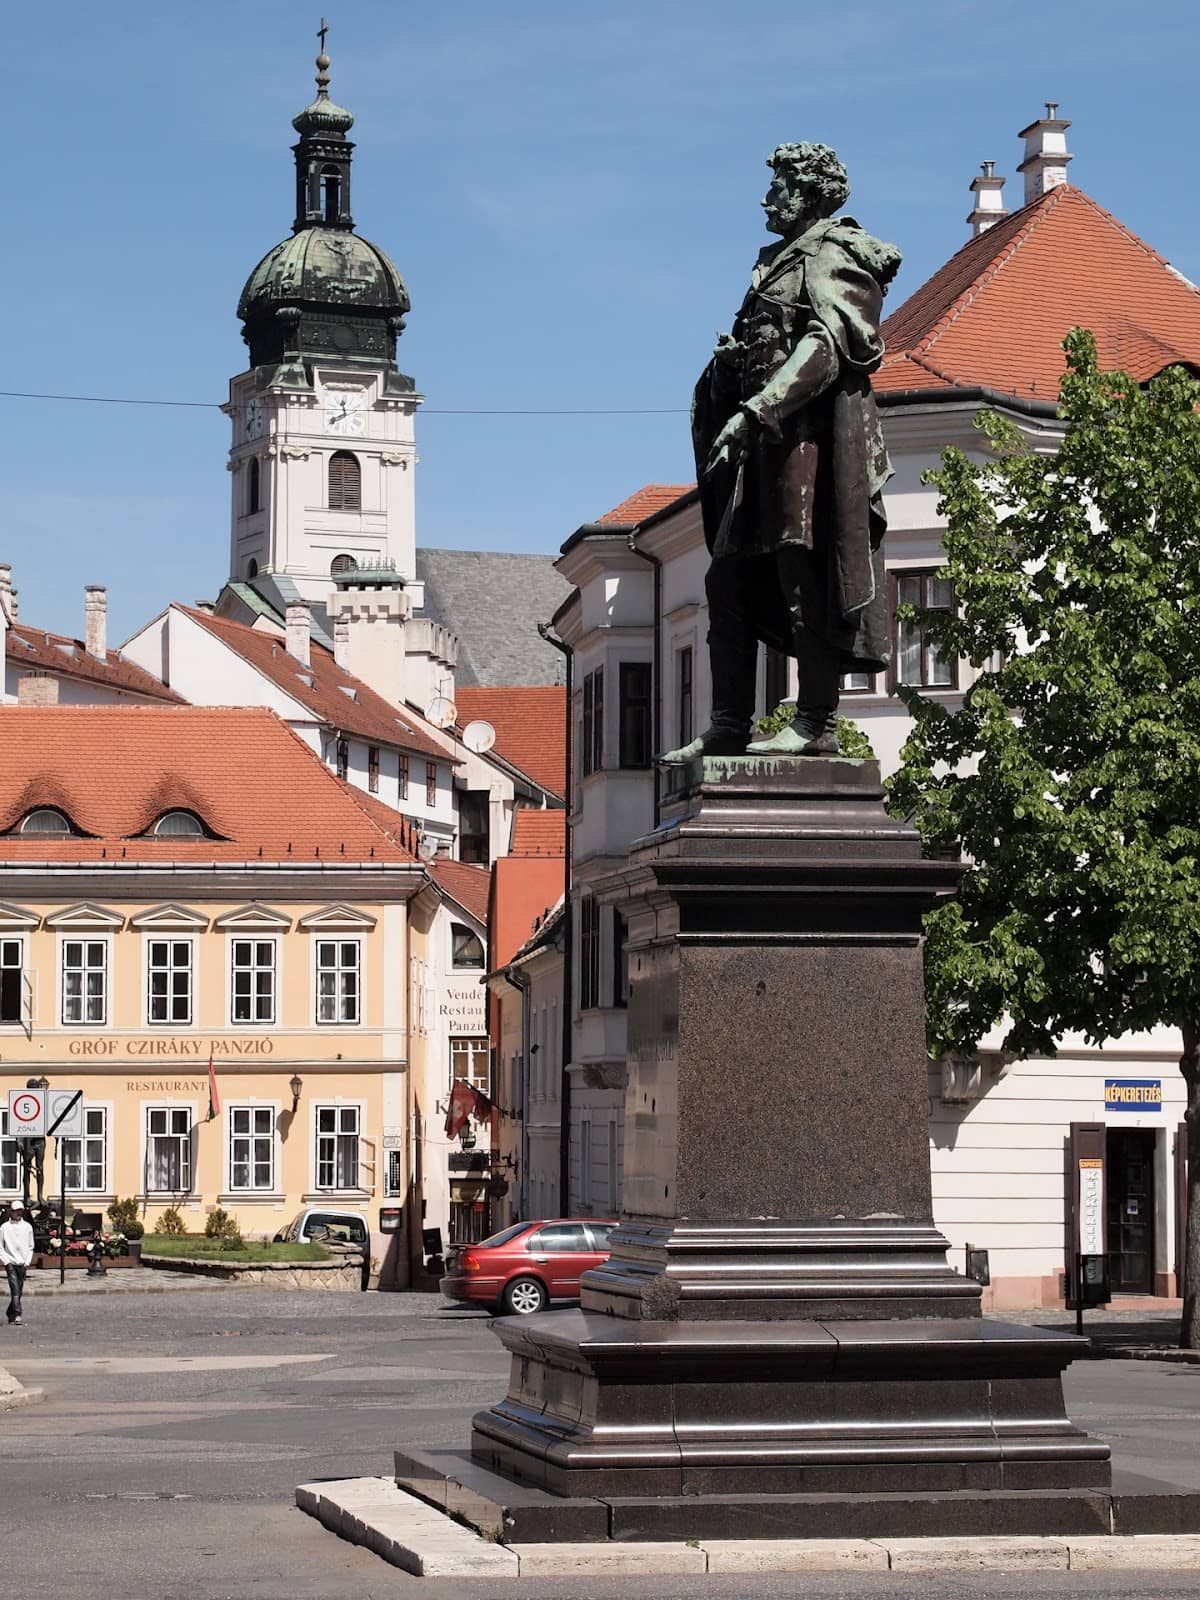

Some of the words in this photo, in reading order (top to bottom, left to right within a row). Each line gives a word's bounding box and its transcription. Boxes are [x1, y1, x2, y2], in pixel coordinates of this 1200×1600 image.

[69, 1037, 119, 1055] GRÓF
[126, 1037, 203, 1055] CZIRÁKY
[210, 1036, 274, 1054] PANZIÓ
[127, 1081, 208, 1092] RESTAURANT
[1105, 1082, 1161, 1103] KÉPKERETEZÉS
[23, 1102, 30, 1114] 5
